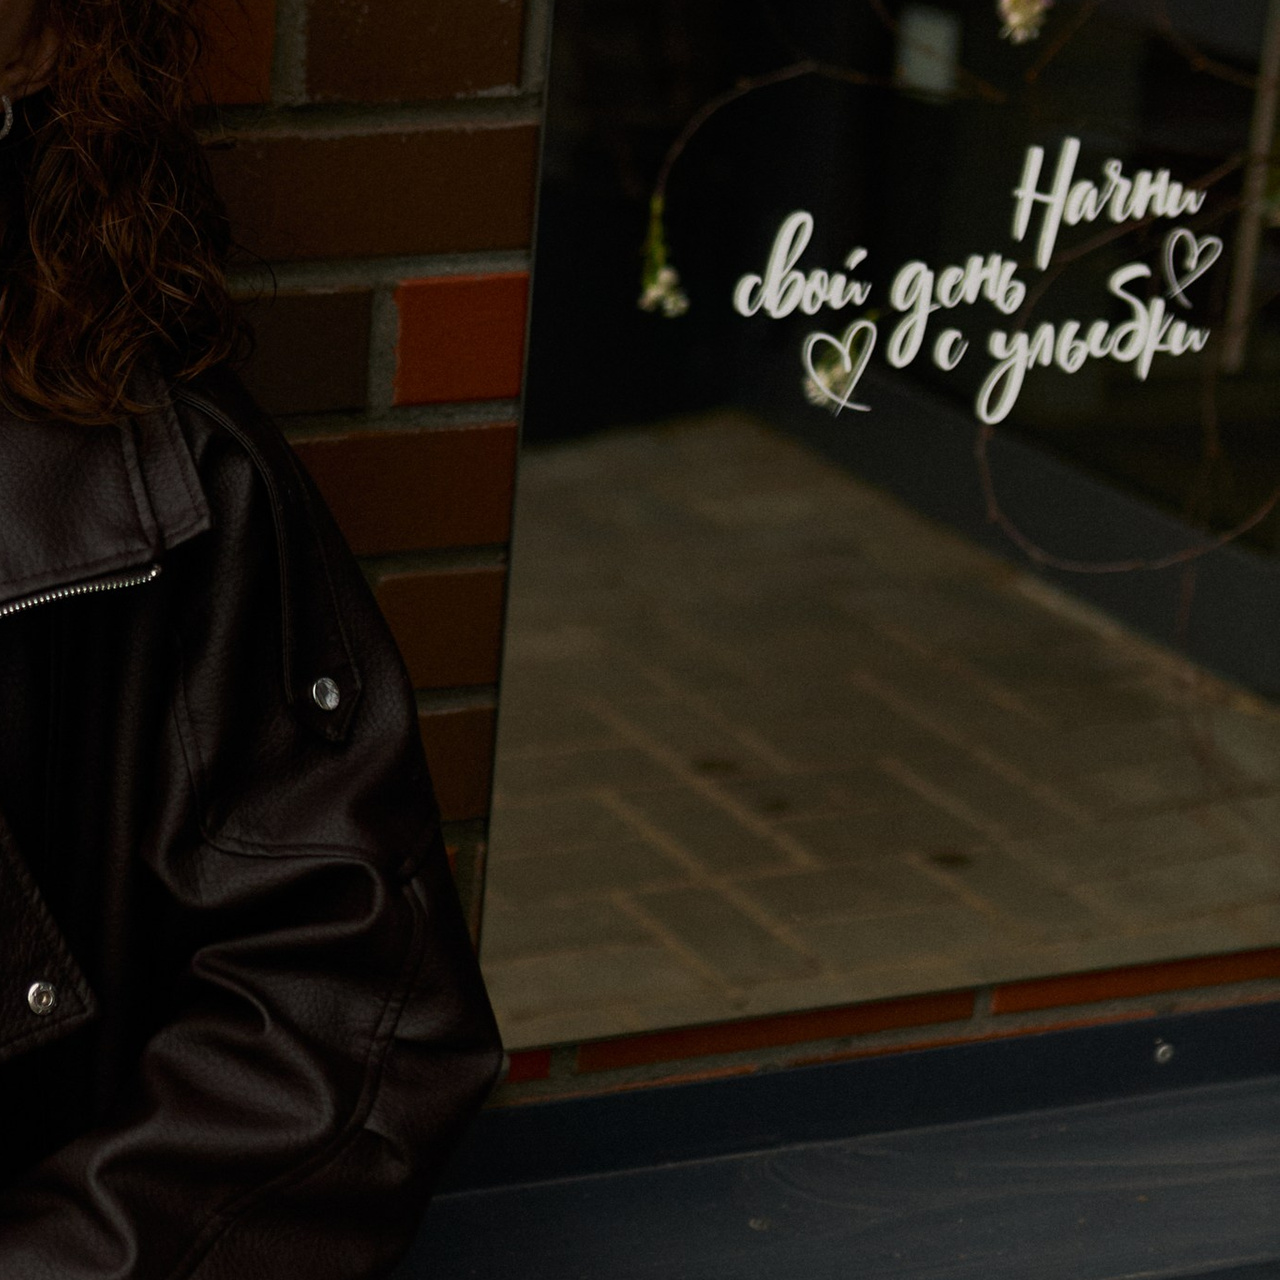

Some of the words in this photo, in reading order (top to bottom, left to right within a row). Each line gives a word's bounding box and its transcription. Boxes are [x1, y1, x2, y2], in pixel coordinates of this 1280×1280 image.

[1012, 136, 1207, 272] Начни
[733, 210, 872, 320] свой
[886, 253, 1027, 369] день
[933, 328, 969, 371] с
[975, 262, 1211, 425] улыбки
